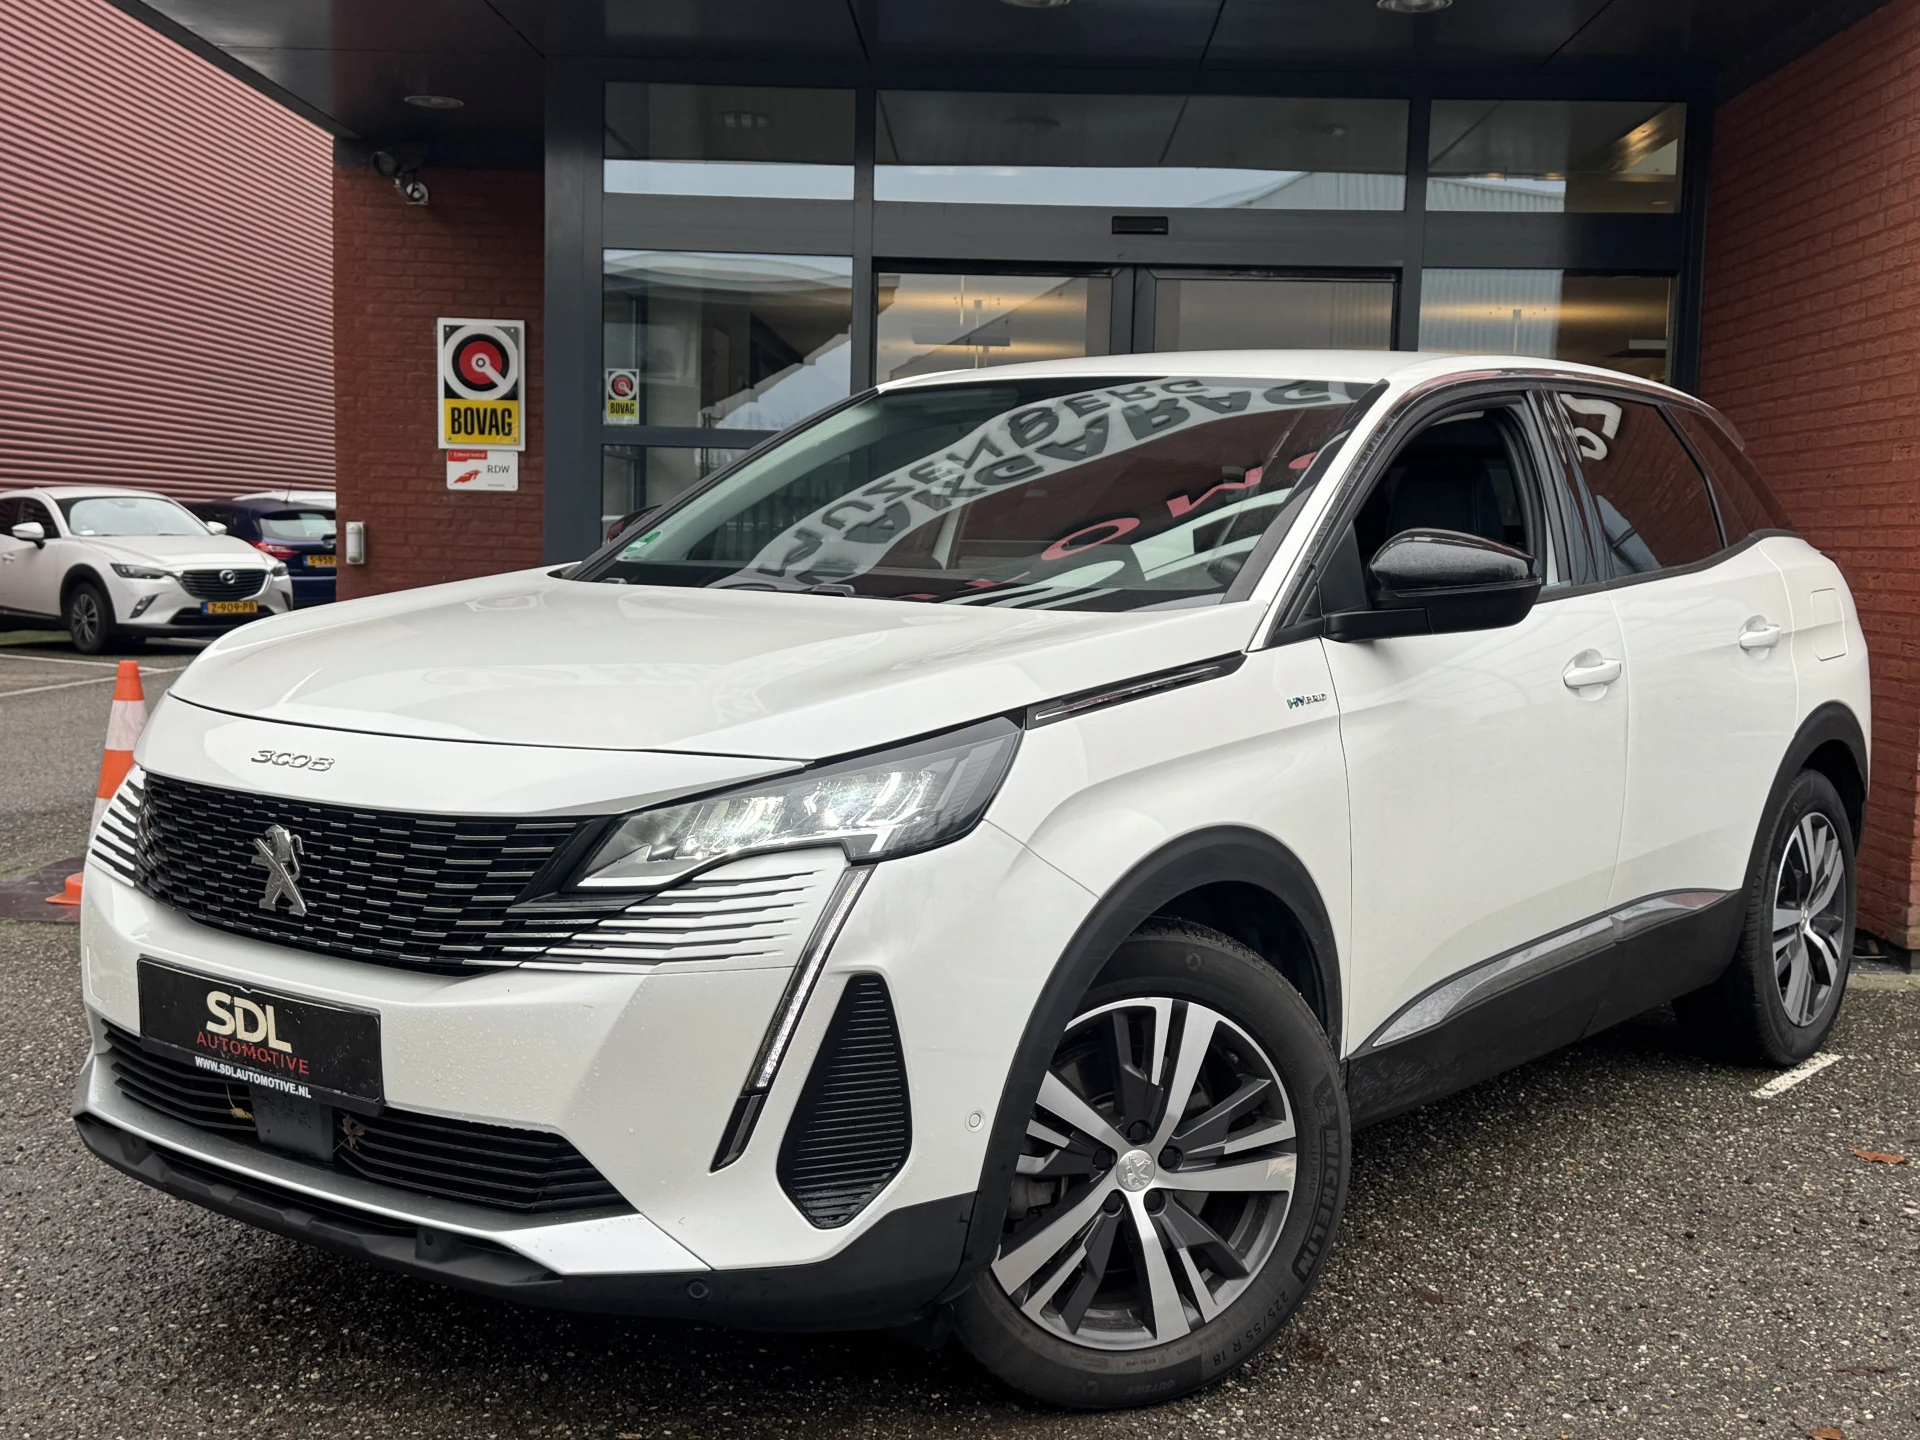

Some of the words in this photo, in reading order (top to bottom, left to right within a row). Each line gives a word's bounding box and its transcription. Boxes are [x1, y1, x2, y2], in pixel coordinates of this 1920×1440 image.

[610, 402, 635, 414] BOVAG
[451, 407, 513, 436] BOVAG
[486, 464, 510, 474] RDW
[211, 602, 255, 613] Z-909-PB
[1286, 693, 1327, 709] HYBRID
[251, 750, 335, 772] 3008
[206, 990, 293, 1054] SDL
[196, 1031, 309, 1075] AUTOMOTIVE
[194, 1056, 312, 1099] WWW.SDLAUTOMOTIVE.NL
[1297, 1128, 1340, 1279] MICHELIN
[1245, 1290, 1289, 1343] 225/55
[1232, 1338, 1243, 1353] R
[1213, 1349, 1228, 1366] 18
